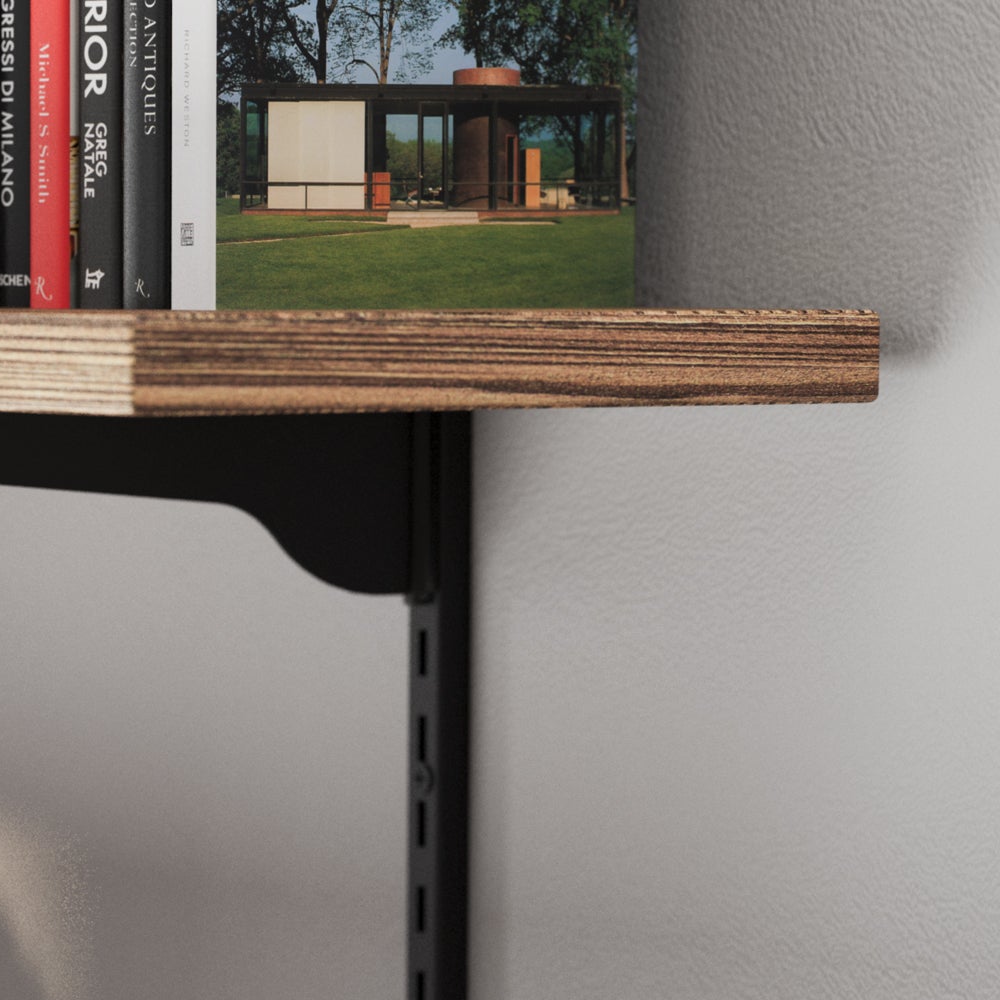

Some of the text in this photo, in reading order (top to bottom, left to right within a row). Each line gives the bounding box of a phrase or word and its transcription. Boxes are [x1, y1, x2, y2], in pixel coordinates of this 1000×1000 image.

[83, 0, 108, 98] RIOR
[129, 2, 137, 68] ECTION
[143, 16, 157, 136] ANTIQUES
[1, 80, 14, 103] DI
[38, 43, 50, 204] Michael S Smith
[1, 111, 14, 207] MILANO
[83, 122, 95, 199] NATALE
[95, 122, 108, 178] GREG
